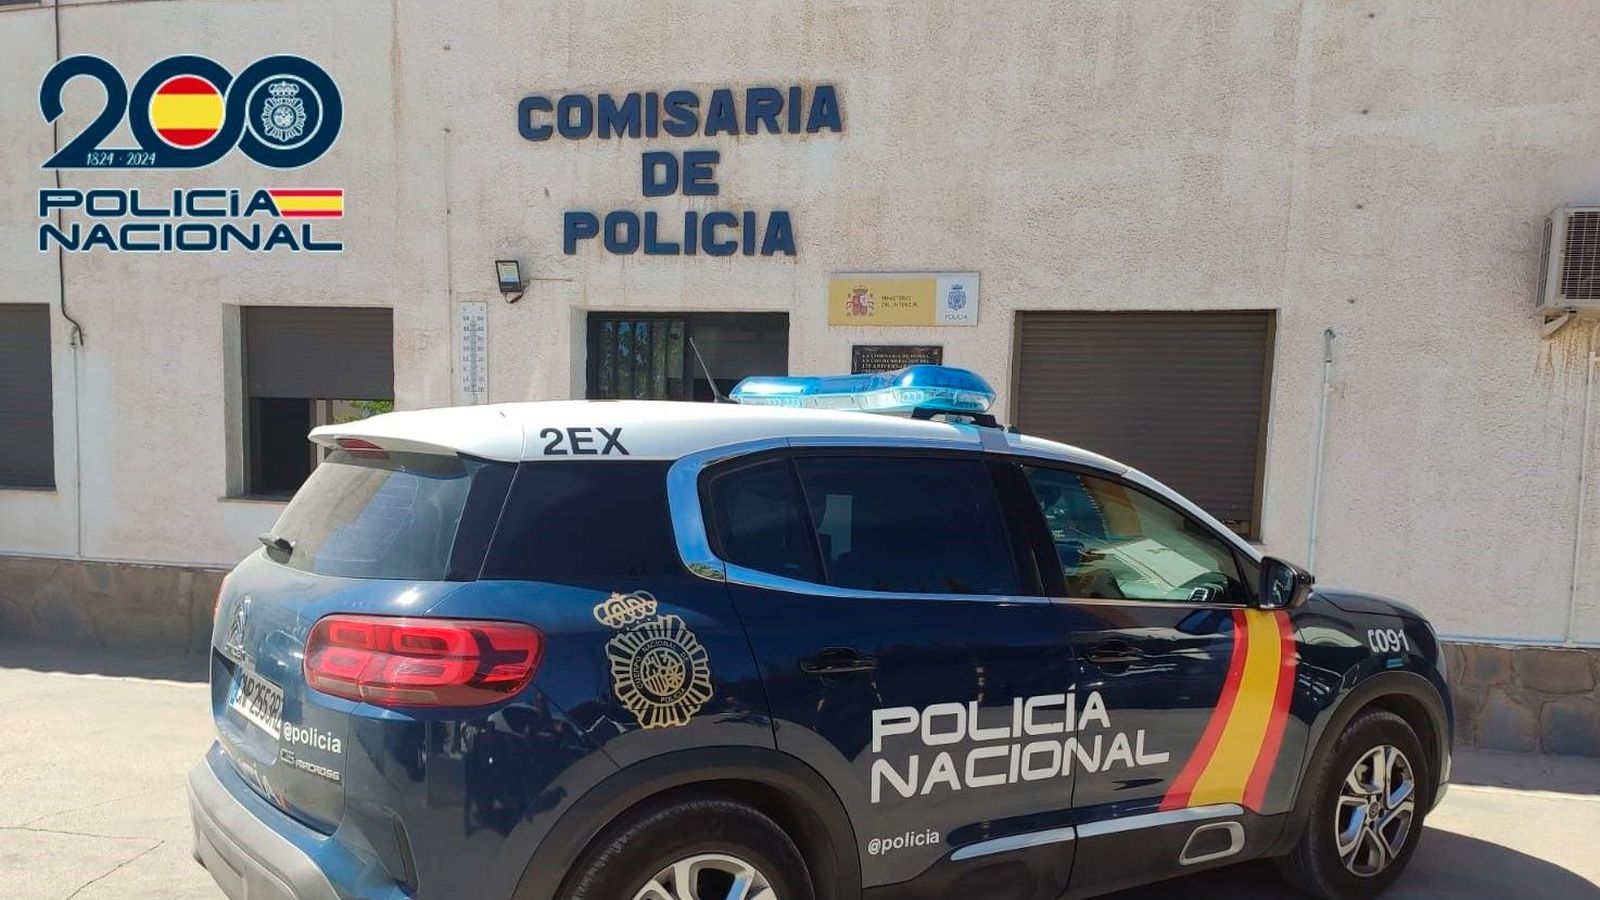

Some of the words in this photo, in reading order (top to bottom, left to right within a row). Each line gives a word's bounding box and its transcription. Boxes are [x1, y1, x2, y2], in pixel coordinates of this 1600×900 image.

[518, 85, 842, 141] COMISARIA
[641, 150, 720, 197] DE
[563, 211, 797, 256] POLICIA
[540, 427, 630, 455] 2EX
[283, 721, 341, 753] @policia
[872, 684, 1111, 753] POLICÍA
[870, 729, 1170, 803] NACIONAL
[868, 828, 940, 855] @policia
